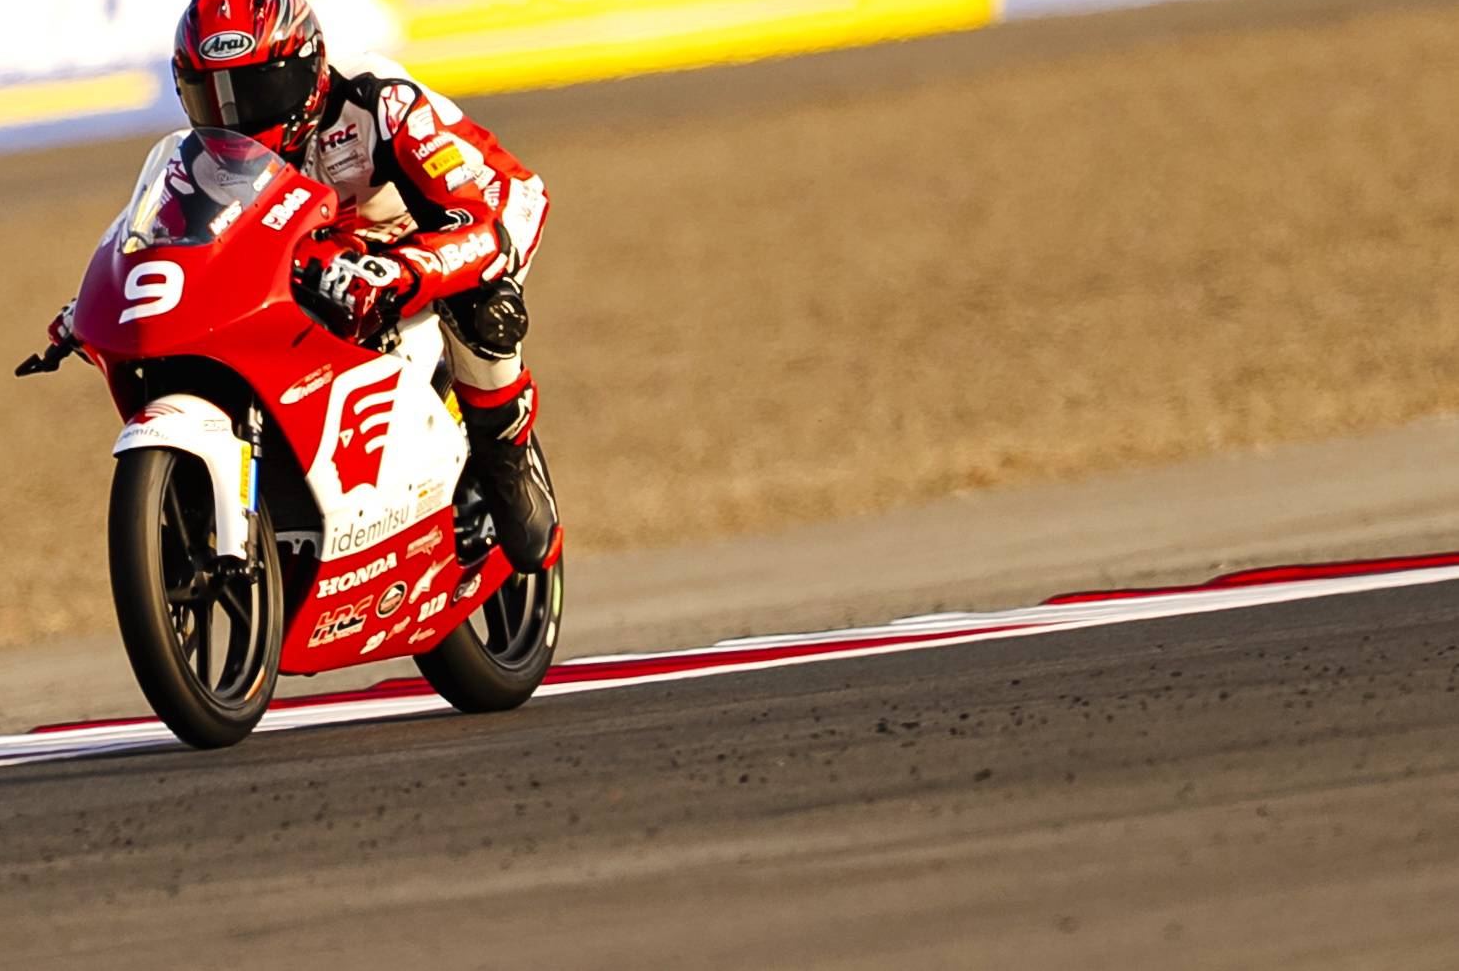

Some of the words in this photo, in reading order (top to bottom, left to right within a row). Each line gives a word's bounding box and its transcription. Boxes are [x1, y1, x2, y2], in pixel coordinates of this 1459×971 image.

[205, 35, 247, 56] Arai
[319, 123, 359, 153] HRC
[272, 187, 312, 223] Beta
[442, 232, 497, 273] Beta
[118, 260, 185, 325] 9
[331, 503, 410, 556] idemitsu
[316, 551, 398, 599] HONDA
